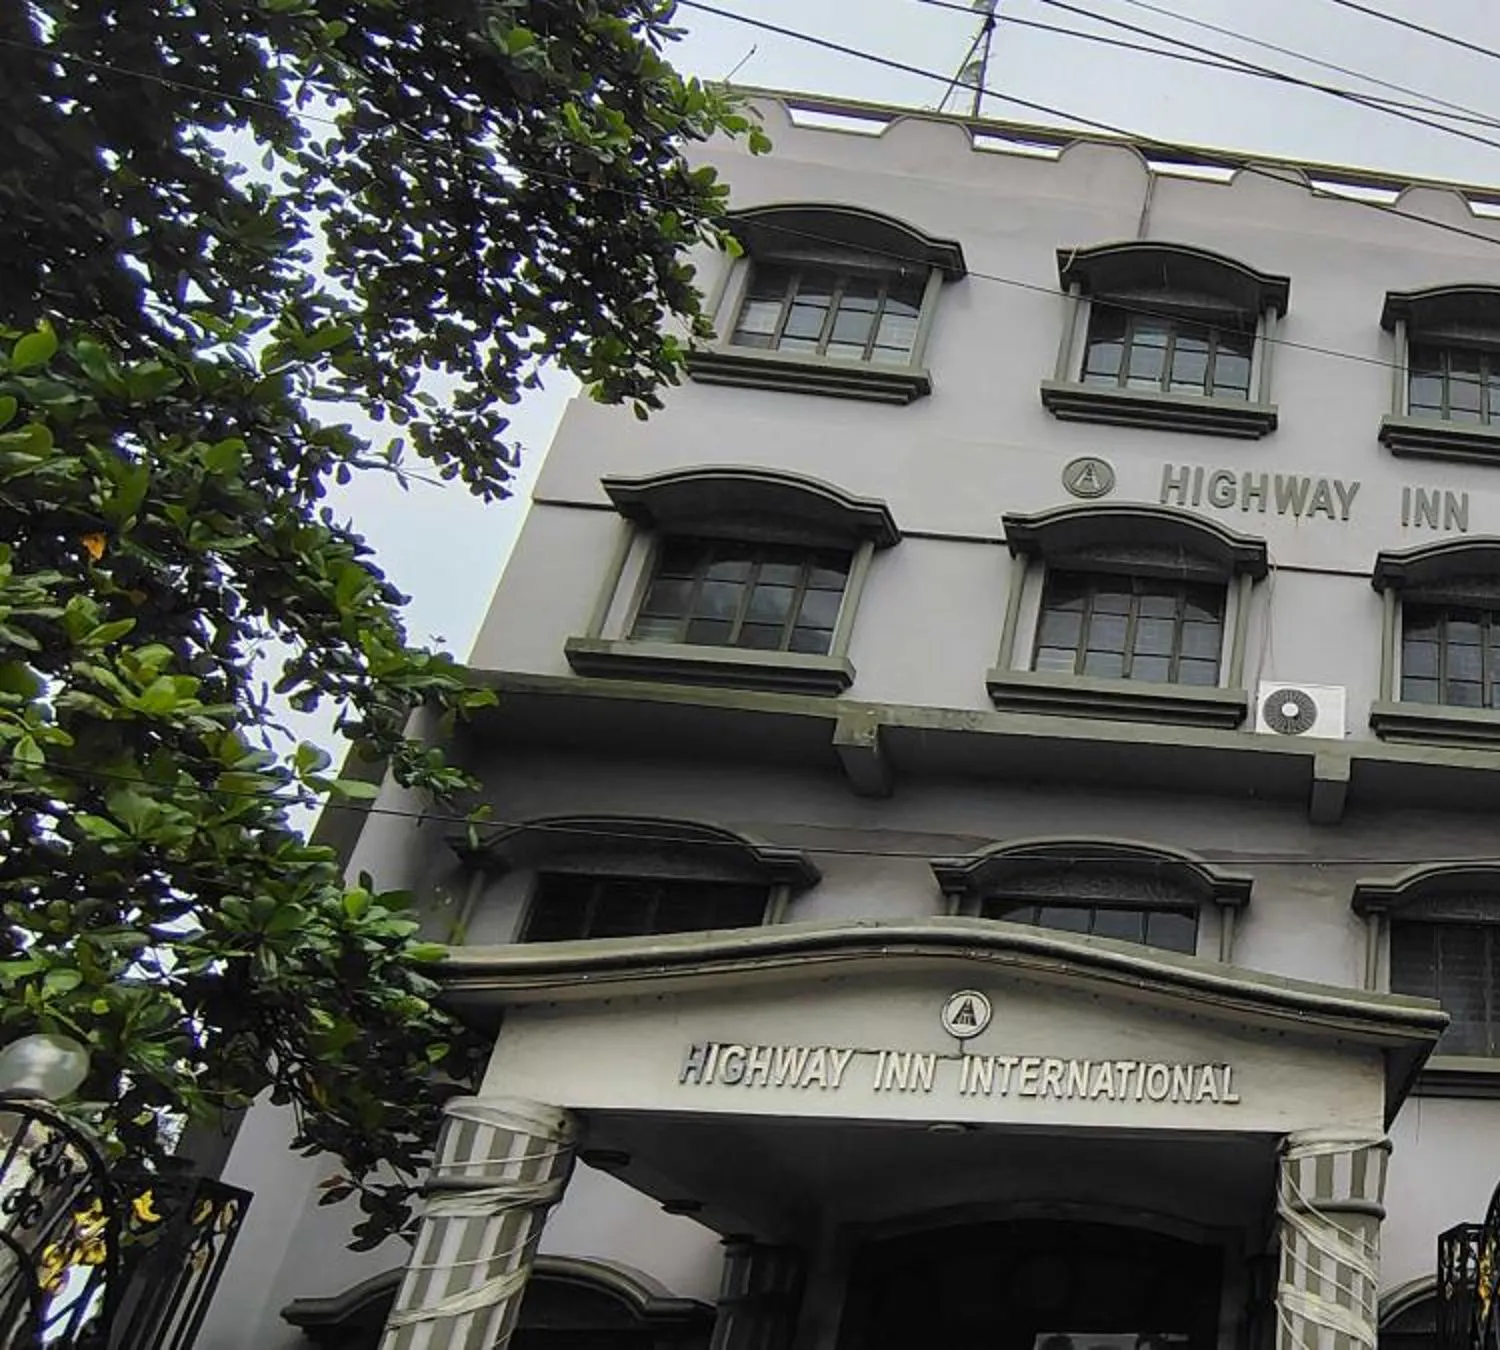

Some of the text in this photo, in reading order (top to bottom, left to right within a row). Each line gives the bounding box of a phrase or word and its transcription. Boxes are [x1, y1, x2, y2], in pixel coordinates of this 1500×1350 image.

[1159, 463, 1361, 523] HIGHWAY
[1401, 487, 1470, 533] INN
[679, 1041, 1240, 1104] HIGHWAY INN INTERNATIONAL
